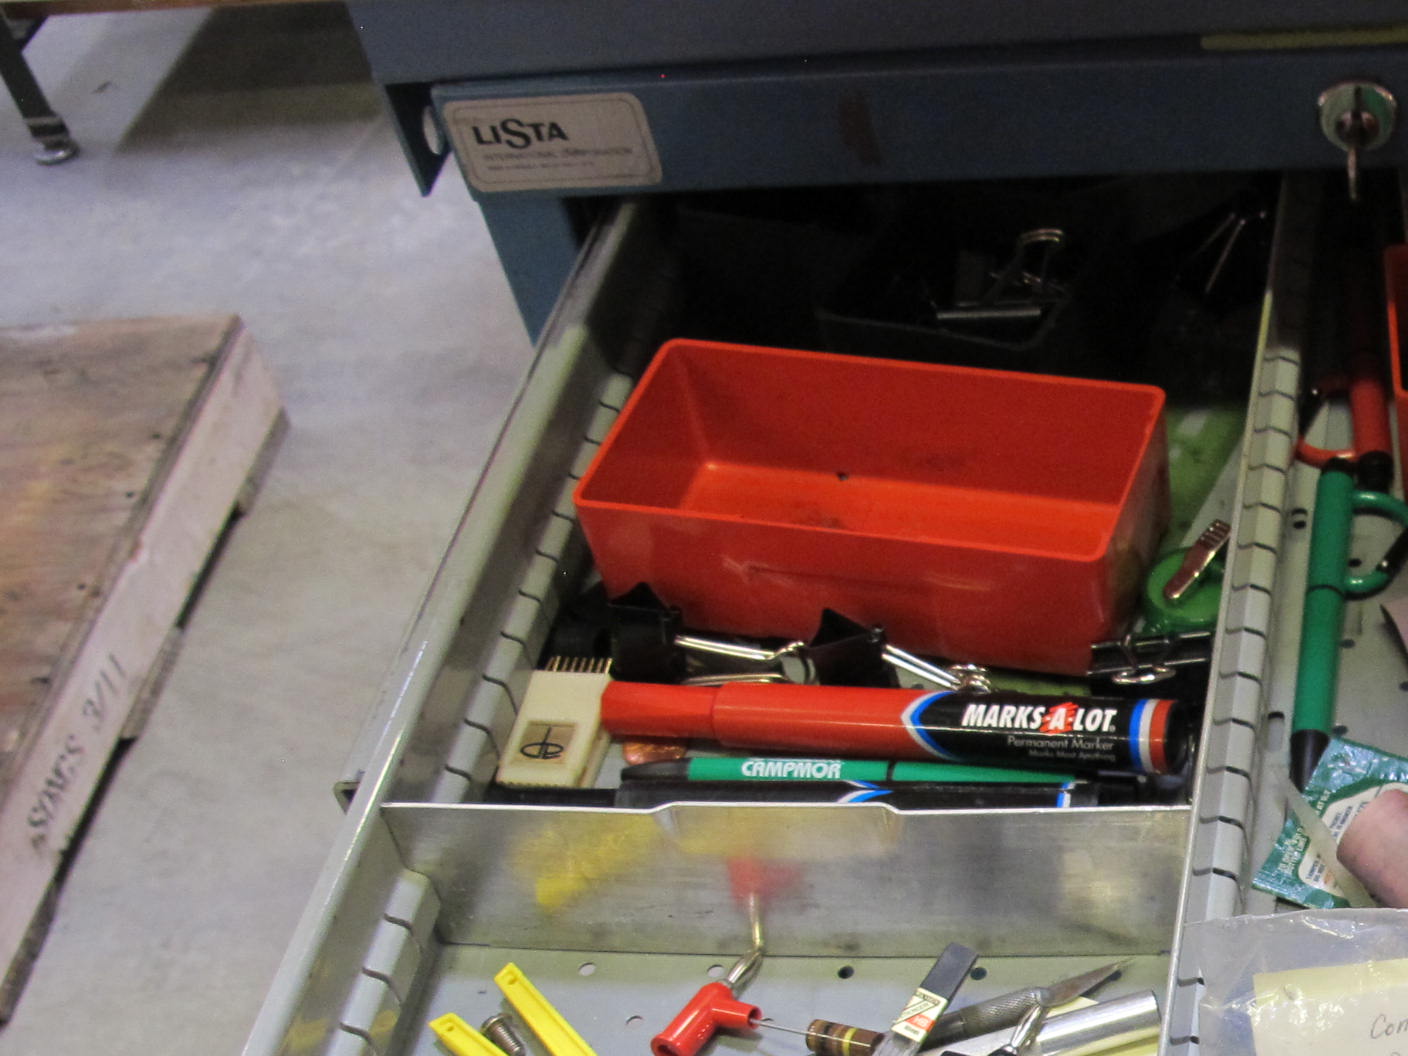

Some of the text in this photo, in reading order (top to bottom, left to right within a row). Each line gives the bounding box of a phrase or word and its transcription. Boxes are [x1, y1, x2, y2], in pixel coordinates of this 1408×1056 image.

[472, 118, 569, 149] LISTA
[1007, 734, 1114, 751] Permanent Marker
[741, 759, 842, 780] CAMPMOR
